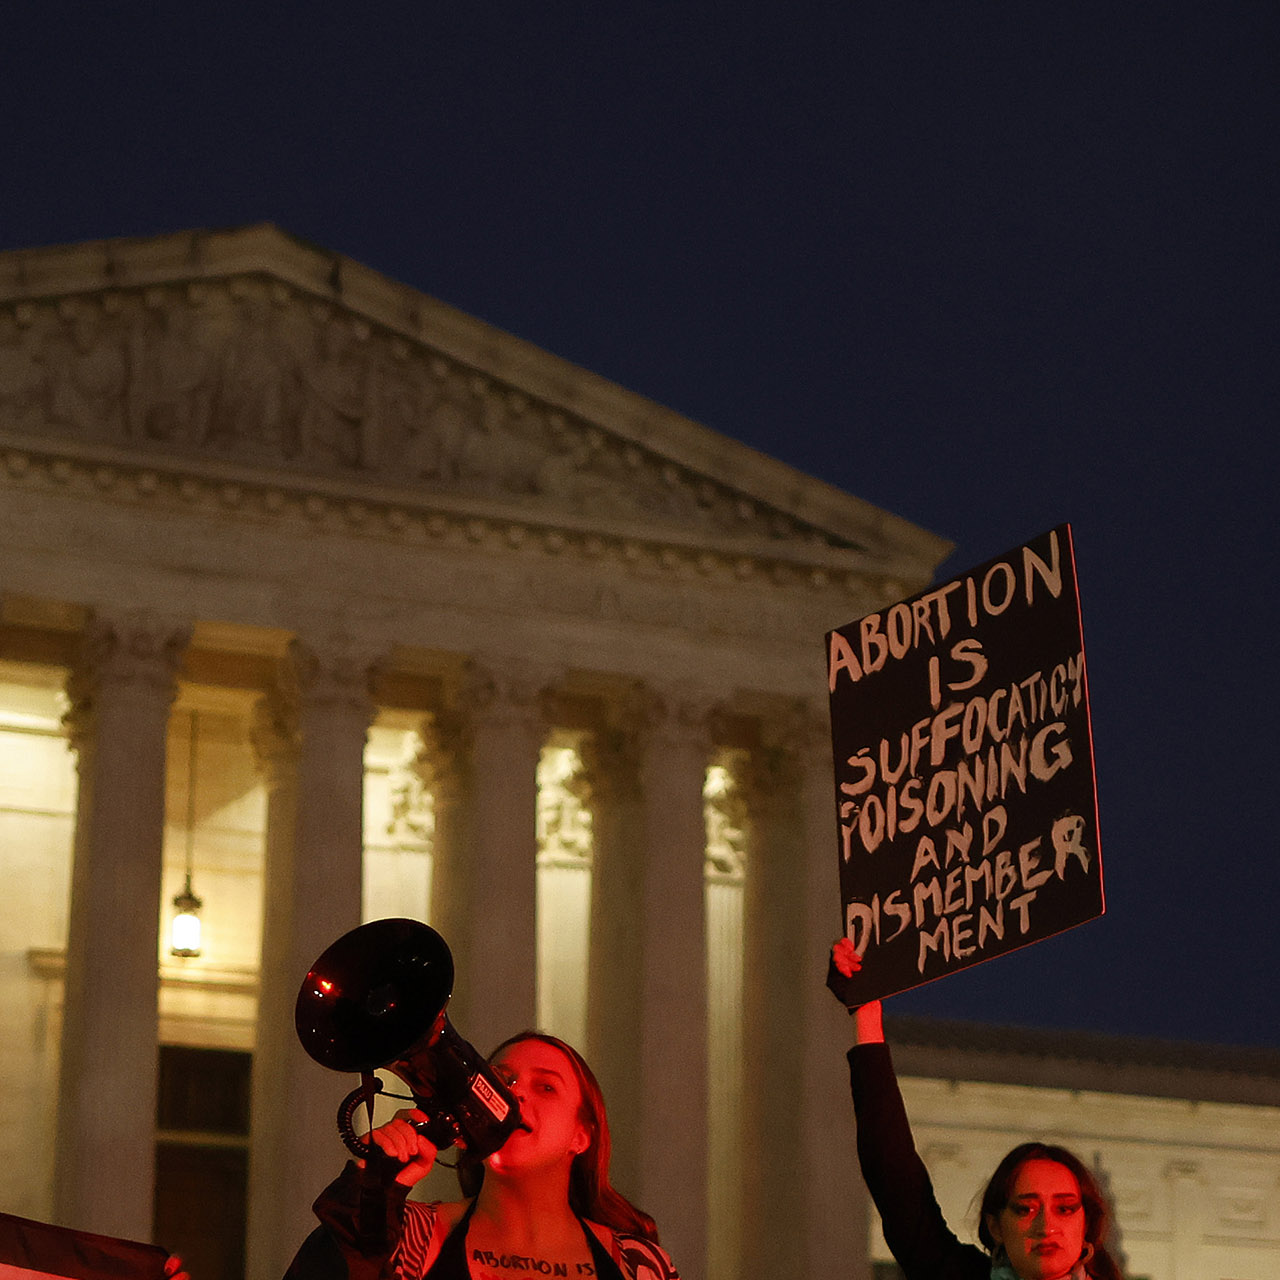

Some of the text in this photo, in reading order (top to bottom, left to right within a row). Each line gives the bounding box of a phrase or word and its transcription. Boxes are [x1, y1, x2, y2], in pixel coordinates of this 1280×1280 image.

[828, 529, 1063, 694] ABORTION
[928, 637, 989, 710] IS
[846, 812, 1092, 957] DISMEMBER
[910, 804, 1008, 884] AND
[917, 889, 1038, 974] MENT
[473, 1249, 595, 1277] ABORTION IS
